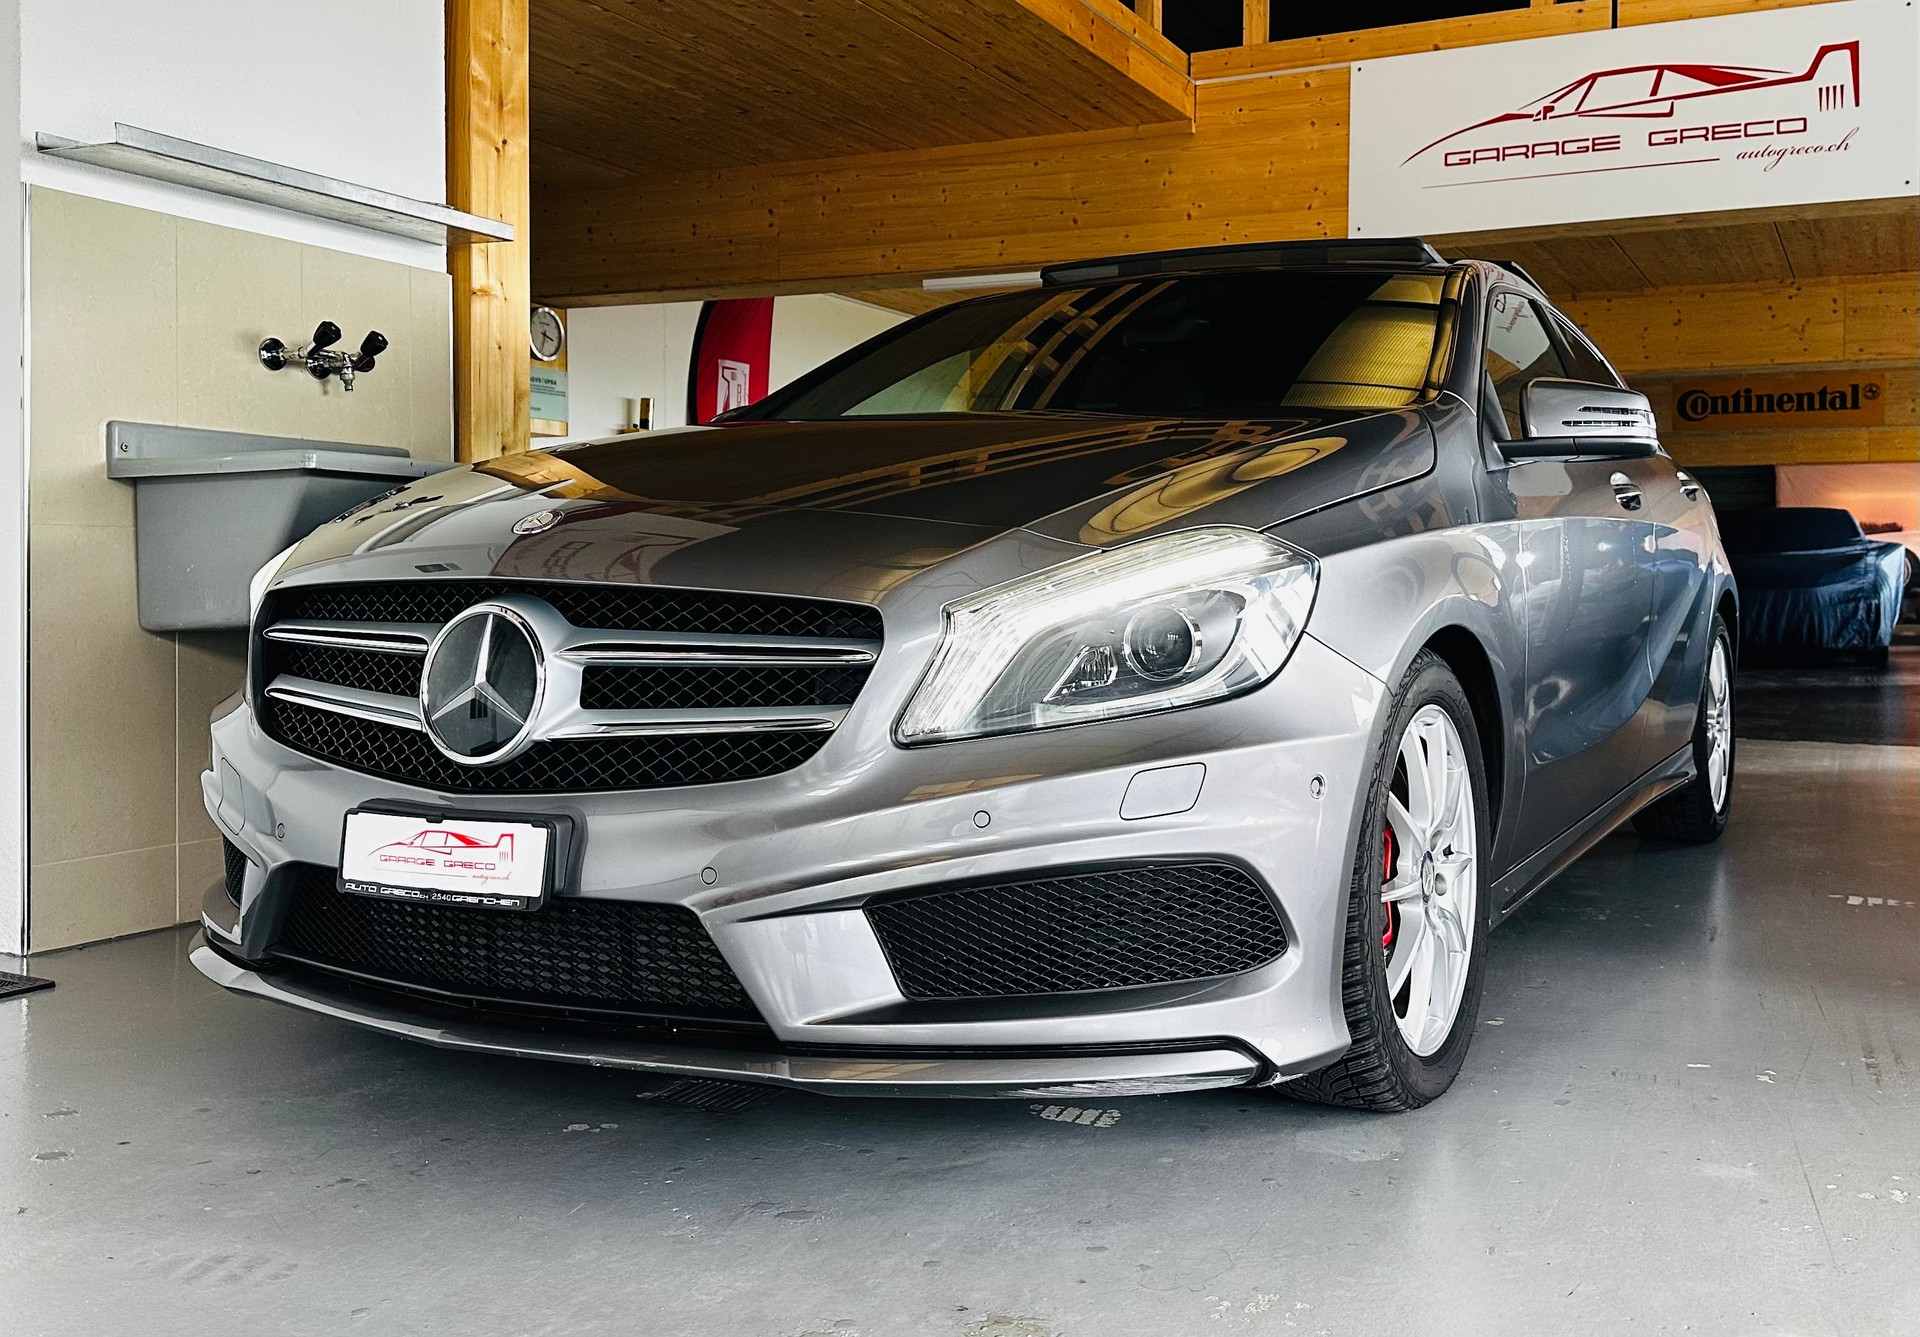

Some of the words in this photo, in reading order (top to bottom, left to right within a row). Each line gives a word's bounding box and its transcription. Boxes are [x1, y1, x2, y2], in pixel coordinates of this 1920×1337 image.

[1444, 134, 1621, 168] GARAGE
[1648, 117, 1807, 147] GRECO
[1736, 126, 1860, 173] autogreco.ch
[1676, 383, 1861, 422] Continental
[379, 854, 435, 866] GARAGE
[443, 859, 496, 871] GRECO
[344, 882, 377, 893] AUTO
[431, 892, 451, 902] 2540
[451, 894, 520, 907] GRENCHEN
